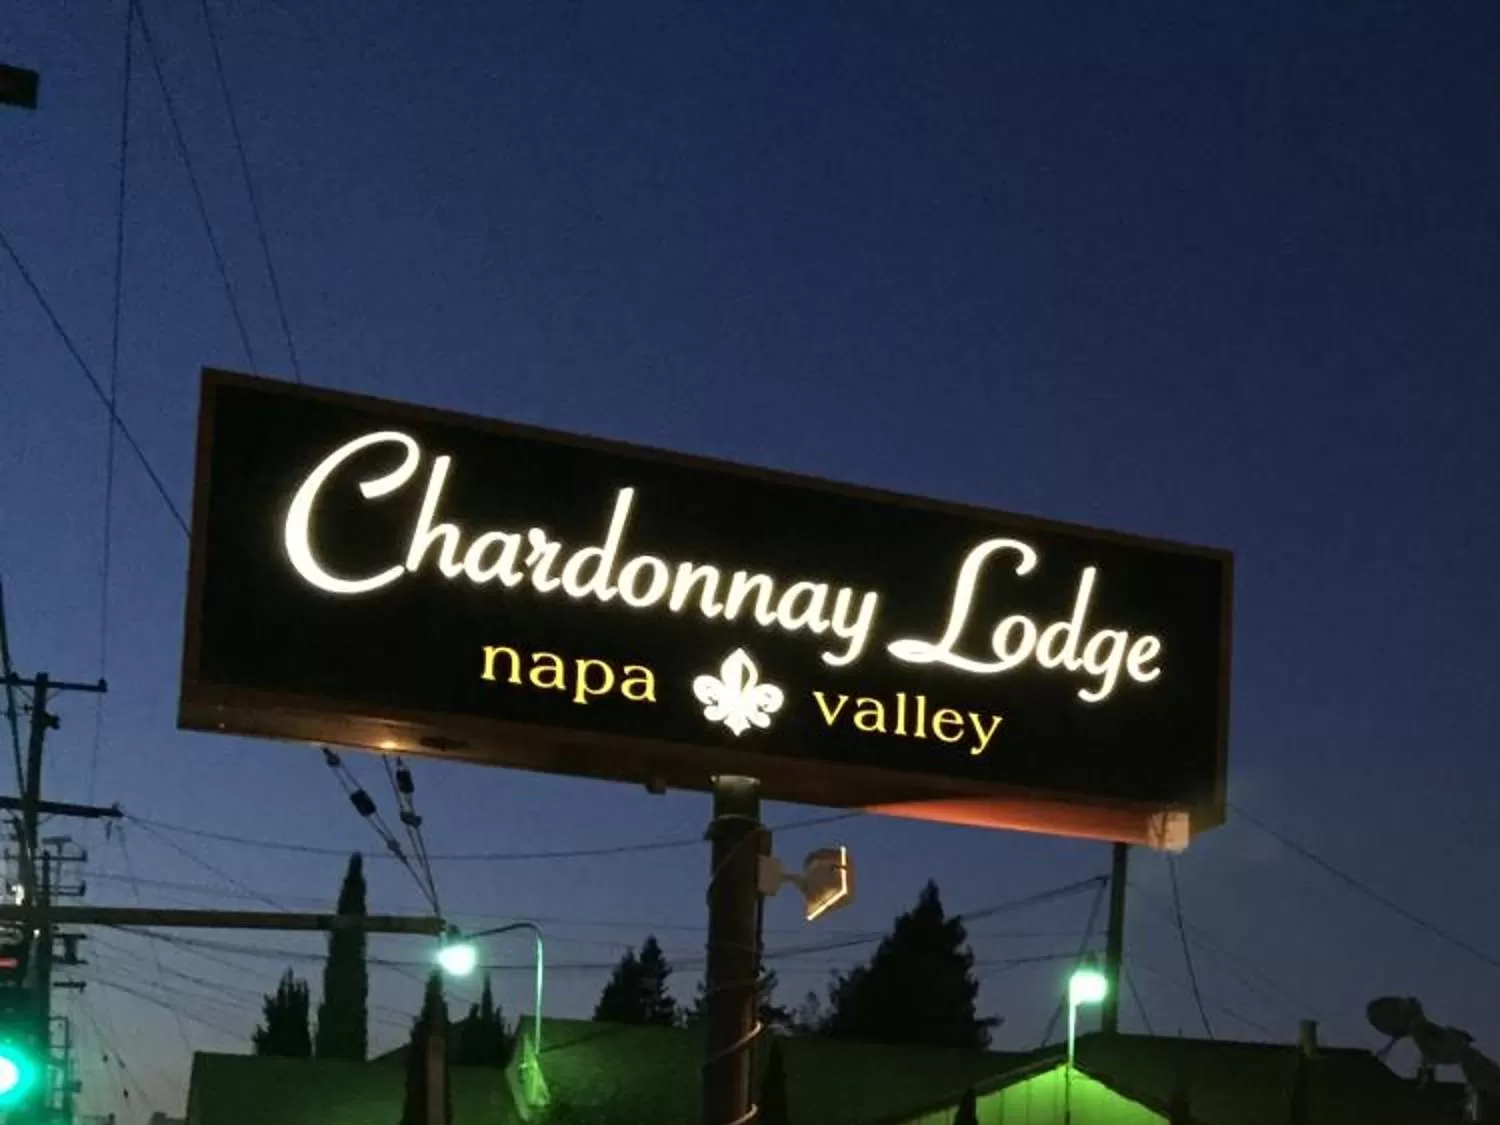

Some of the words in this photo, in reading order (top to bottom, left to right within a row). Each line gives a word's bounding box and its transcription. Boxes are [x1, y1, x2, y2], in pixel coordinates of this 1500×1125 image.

[282, 429, 880, 668] Chardonnay
[886, 537, 1162, 704] Lodge
[480, 644, 659, 706] napa
[811, 690, 1005, 756] valley
